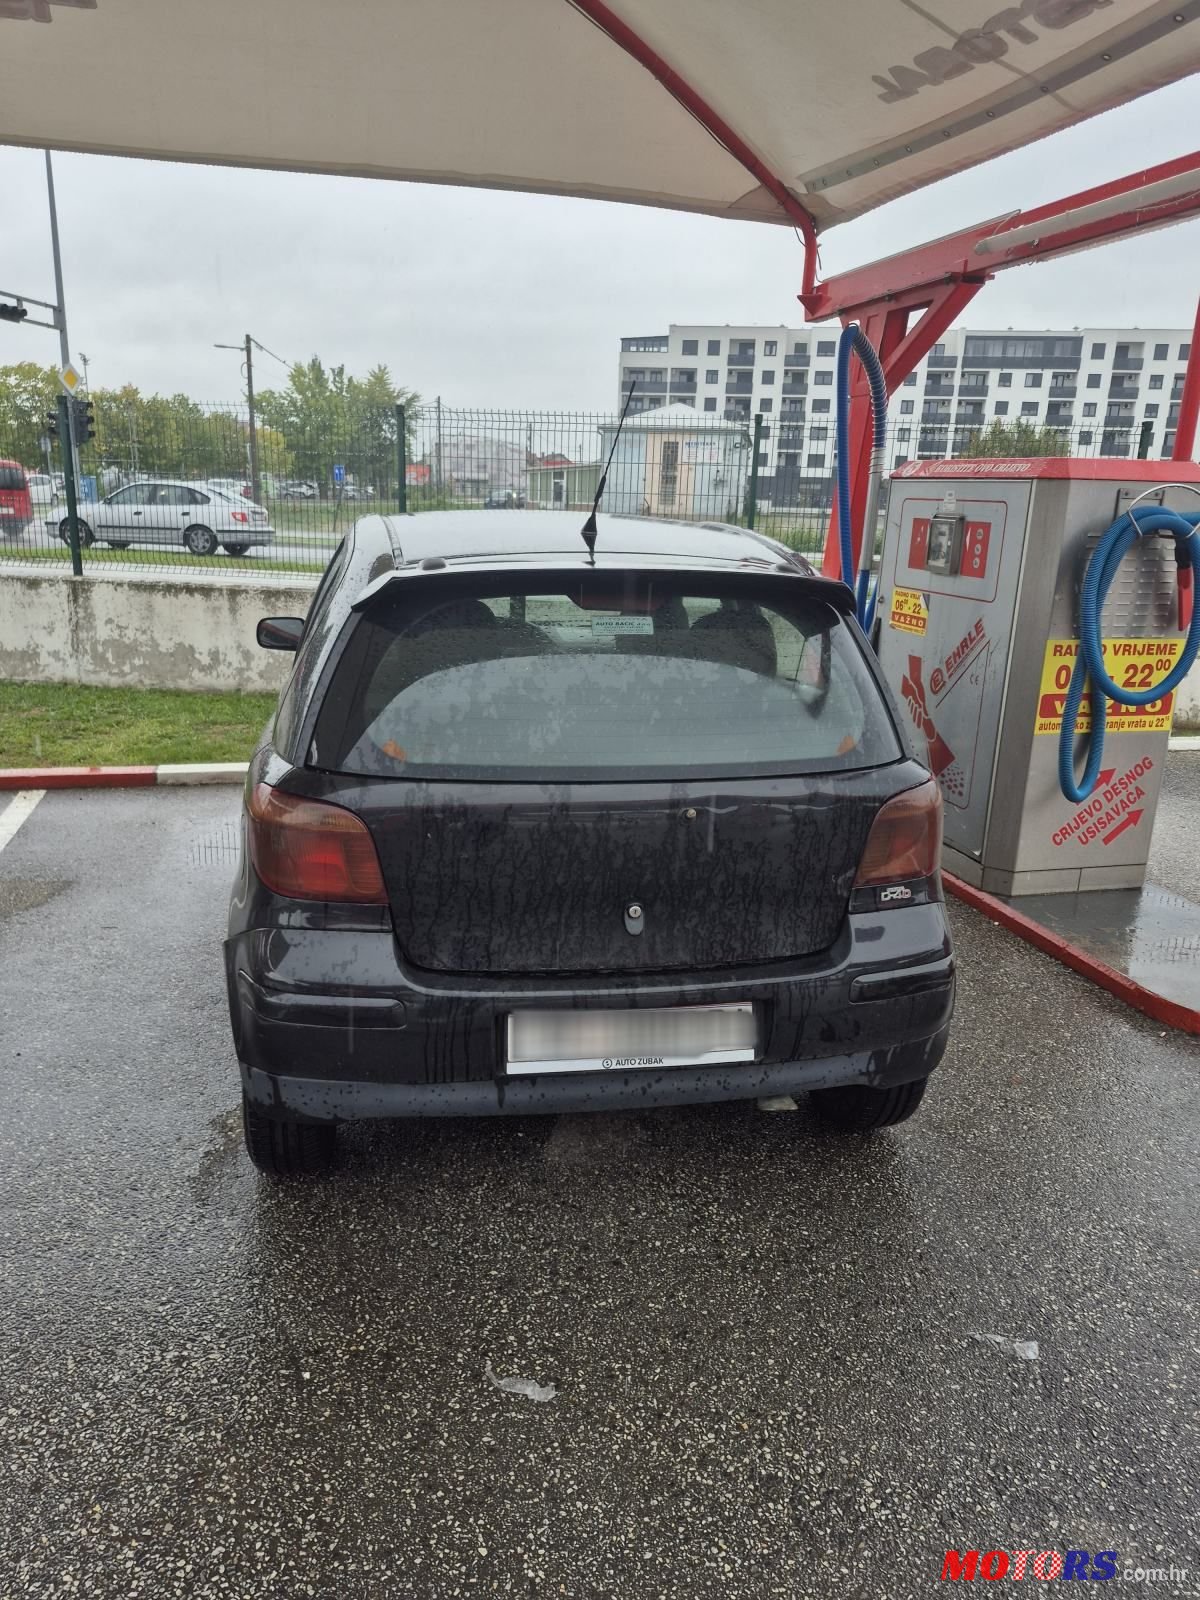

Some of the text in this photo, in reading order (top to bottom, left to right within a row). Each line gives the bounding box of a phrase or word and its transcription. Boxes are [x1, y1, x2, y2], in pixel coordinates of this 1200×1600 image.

[894, 613, 924, 627] VAŽNO
[945, 618, 985, 674] EHRLE
[1113, 643, 1178, 657] VRIJEME
[1127, 718, 1147, 728] vrata
[1051, 756, 1154, 846] CRIJEVO DESNOG
[615, 1057, 664, 1066] AUTO ZUBAK
